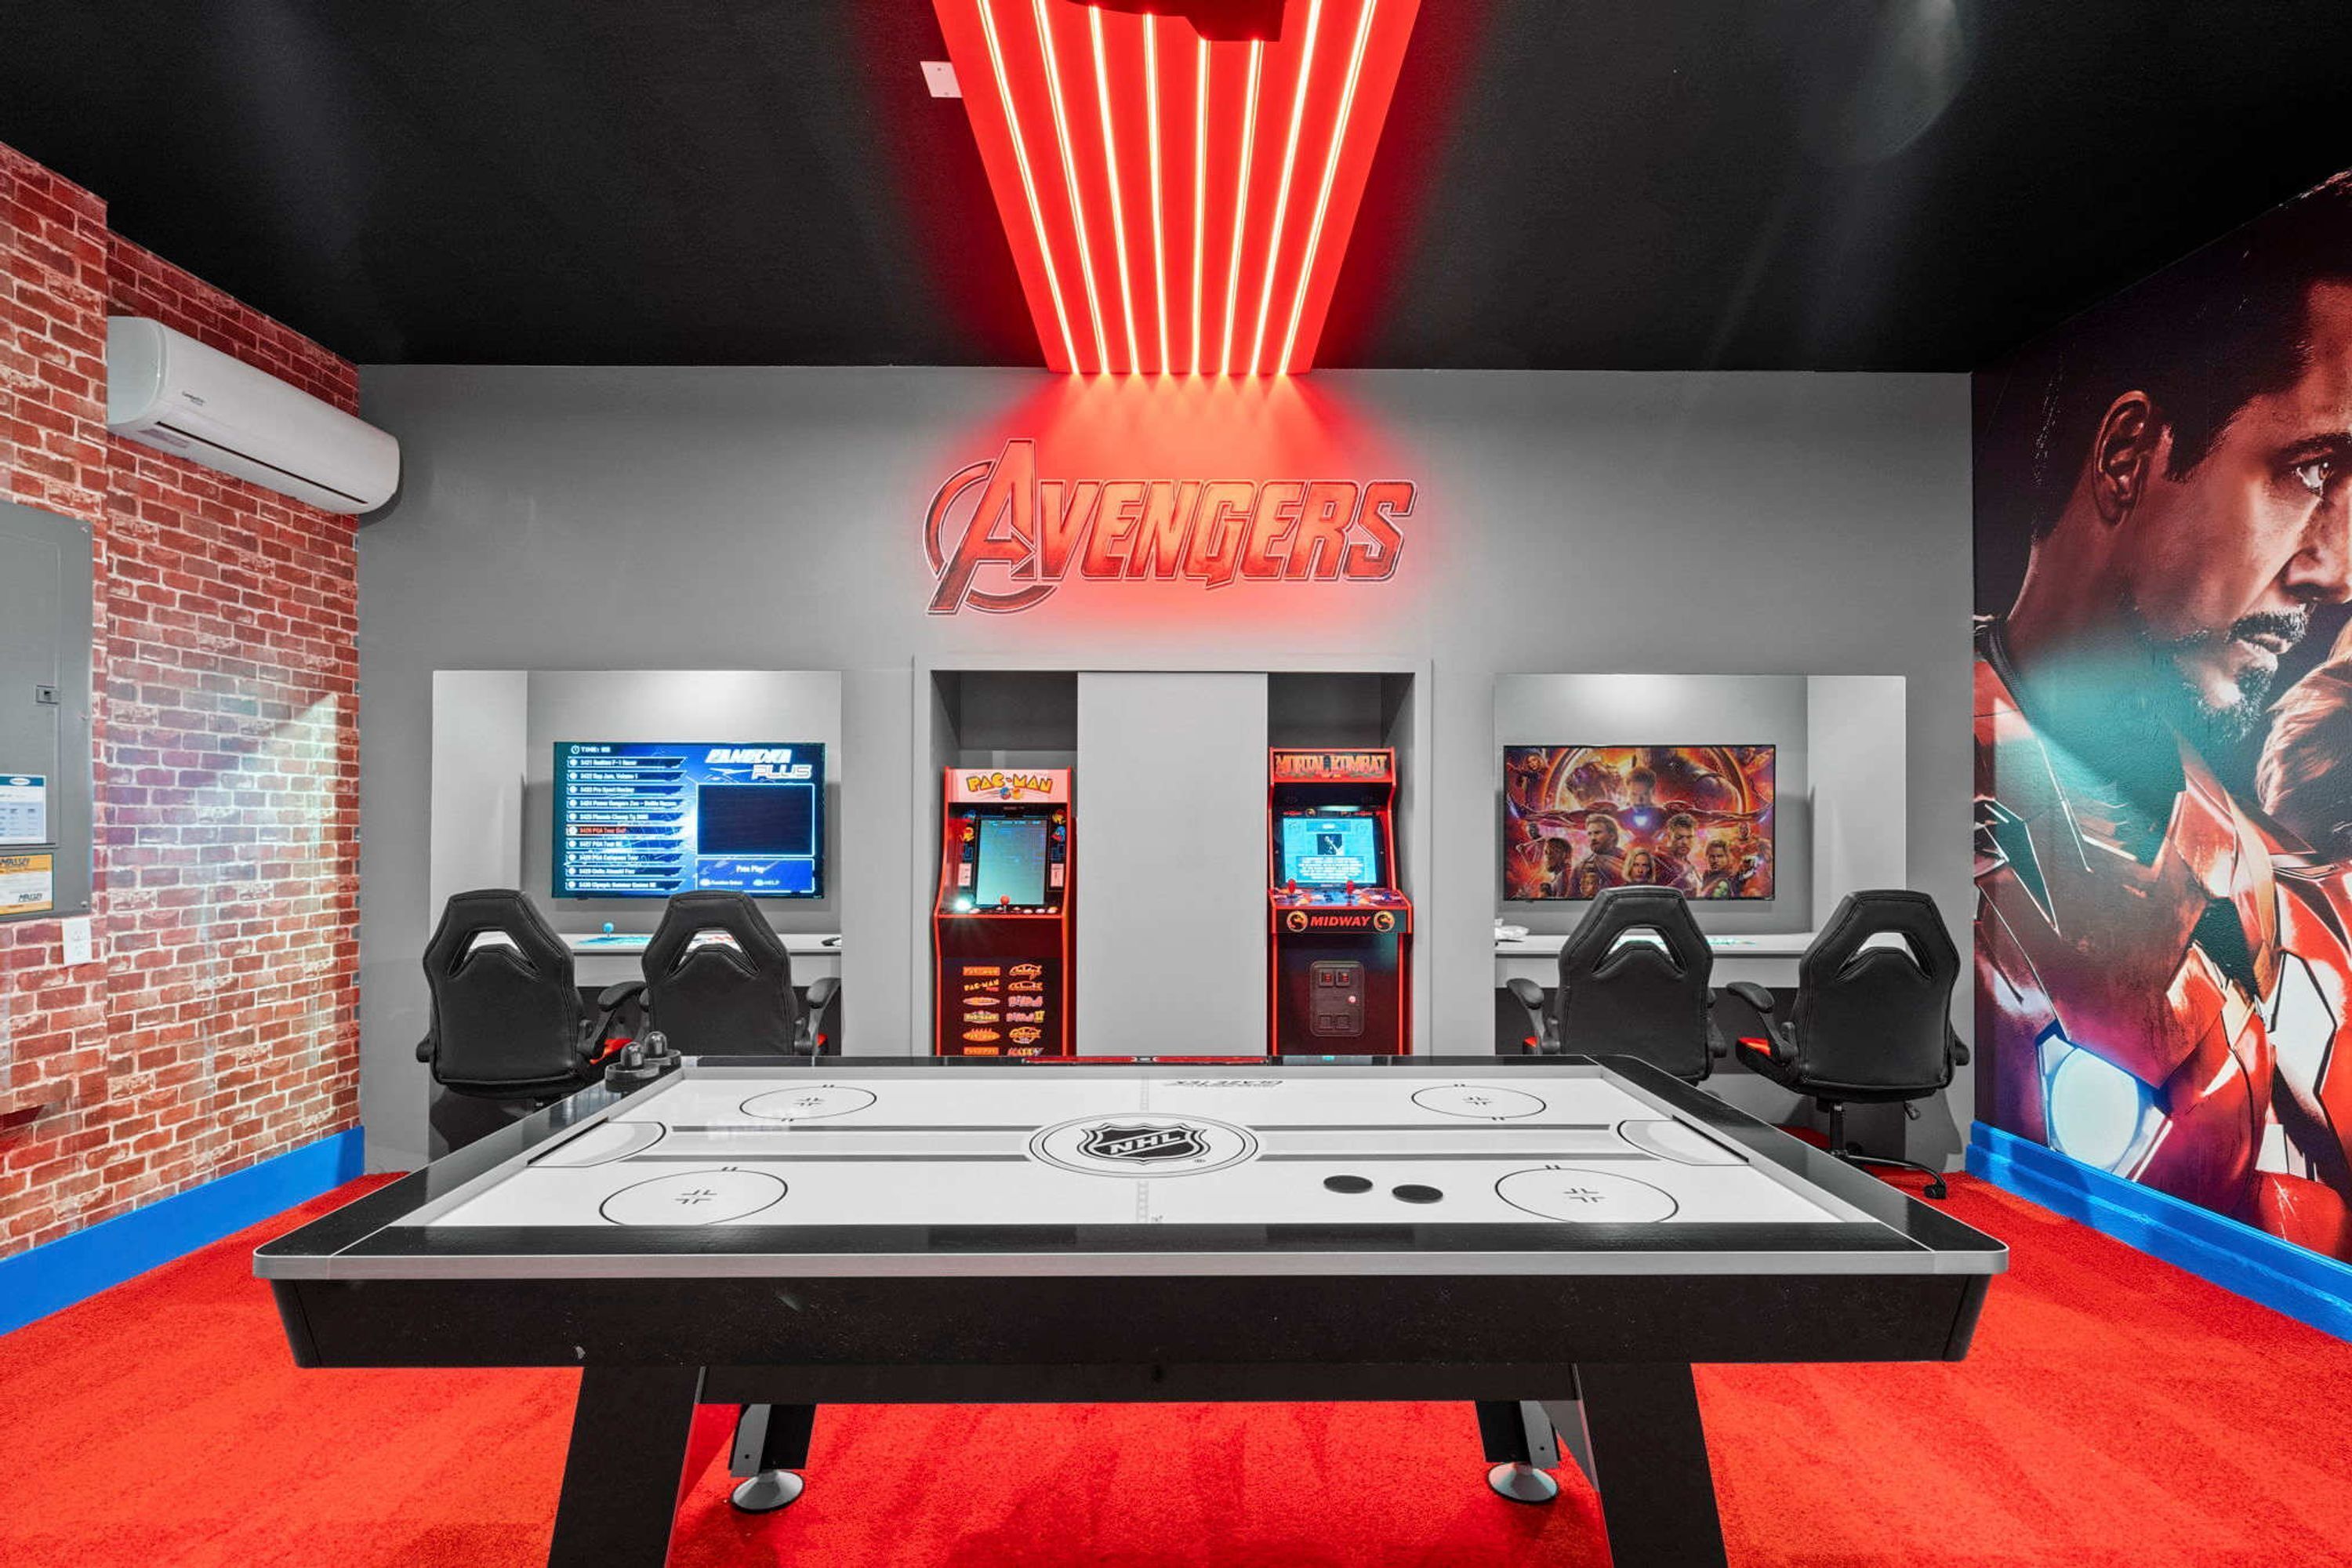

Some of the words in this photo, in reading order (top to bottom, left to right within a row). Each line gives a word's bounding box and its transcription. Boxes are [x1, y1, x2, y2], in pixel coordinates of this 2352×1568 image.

[923, 438, 1417, 615] AVENGERS
[751, 764, 812, 779] PLUS
[966, 772, 1053, 793] PAC-MAN
[1310, 916, 1371, 927] MIDWAY
[1110, 1132, 1181, 1155] NHL
